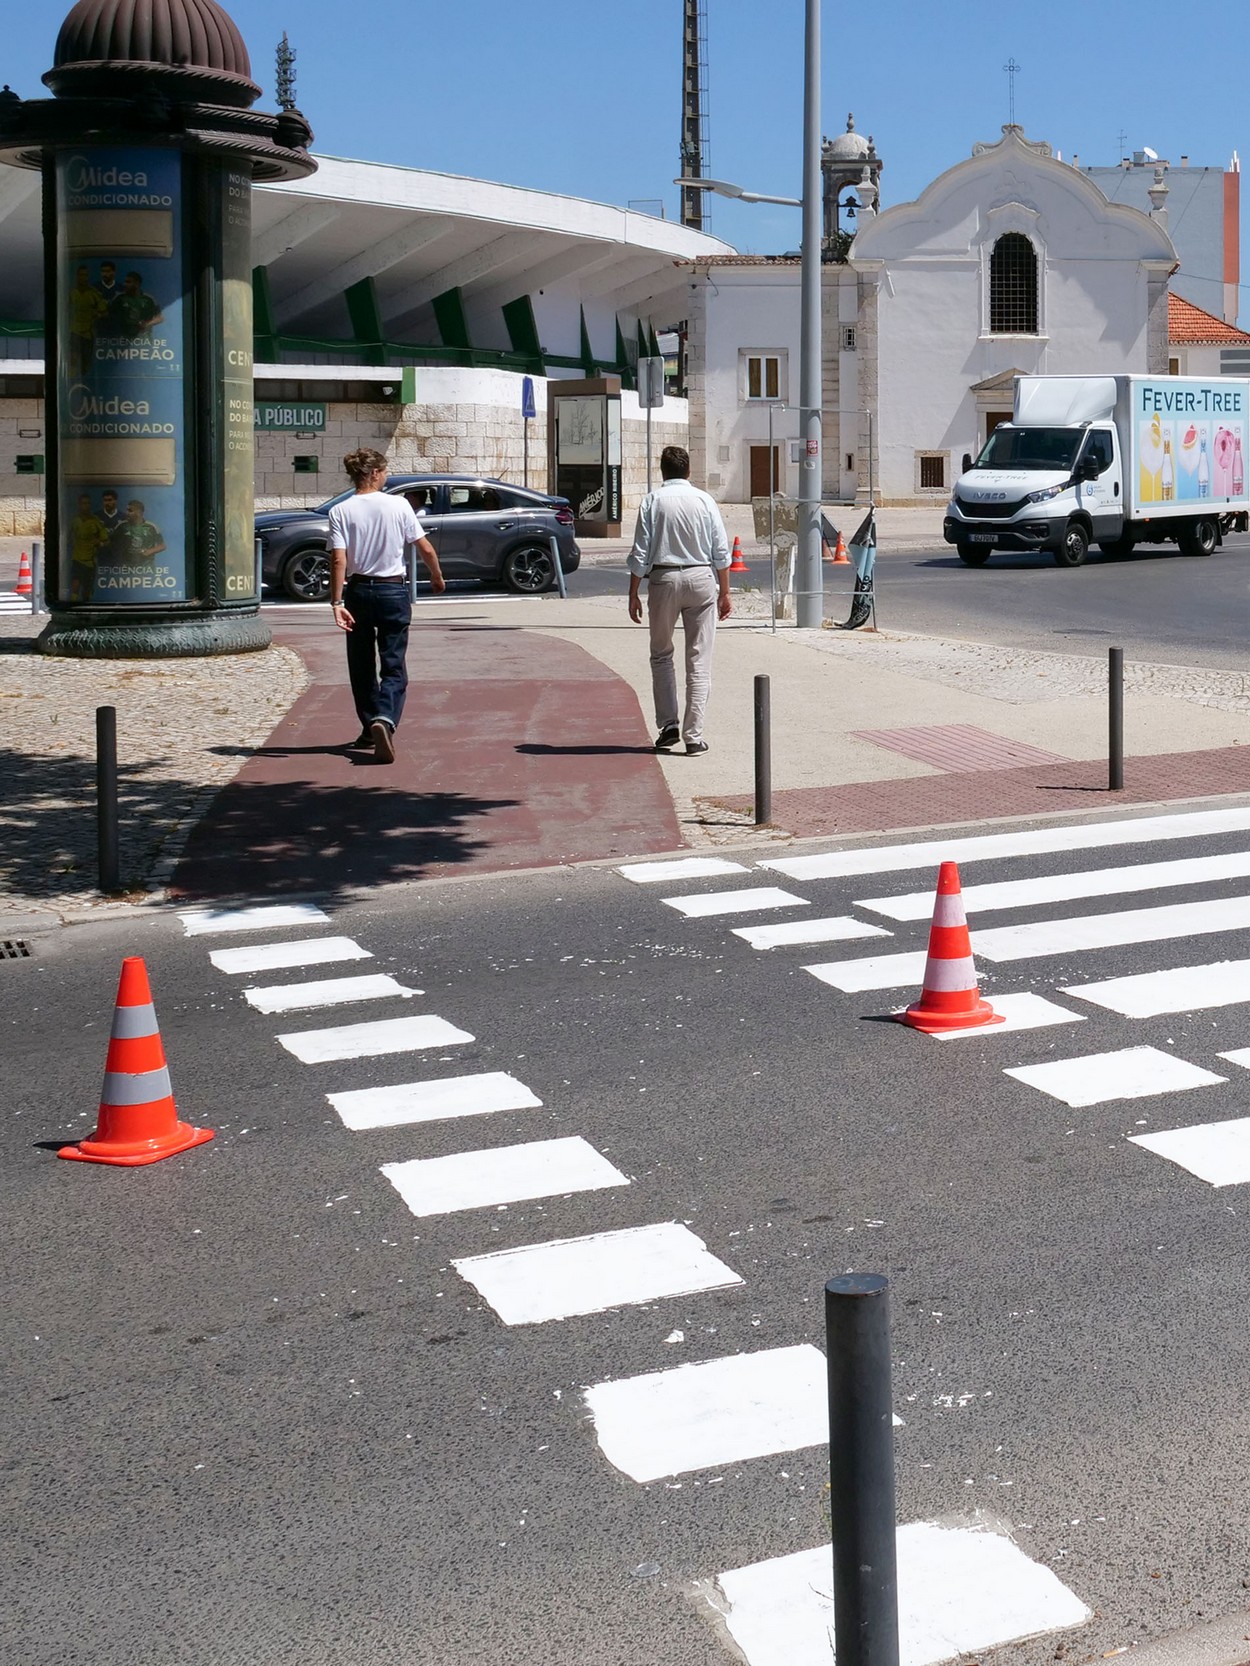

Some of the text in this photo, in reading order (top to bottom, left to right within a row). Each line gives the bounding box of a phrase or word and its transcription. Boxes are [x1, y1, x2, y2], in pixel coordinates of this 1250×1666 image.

[67, 155, 148, 192] Midea
[68, 194, 172, 206] CONDICIONADO
[153, 339, 167, 347] DE
[95, 346, 175, 360] CAMPEÃO
[68, 384, 150, 420] Midea
[229, 400, 241, 409] NO
[1143, 388, 1241, 411] FEVER-TREE
[229, 413, 241, 422] DO
[265, 405, 323, 426] PÚBLICO
[70, 423, 175, 434] CONDICIONADO
[973, 492, 1007, 500] IVECO
[98, 565, 154, 575] EFICIÊNCIA
[97, 574, 177, 588] CAMPEÃO
